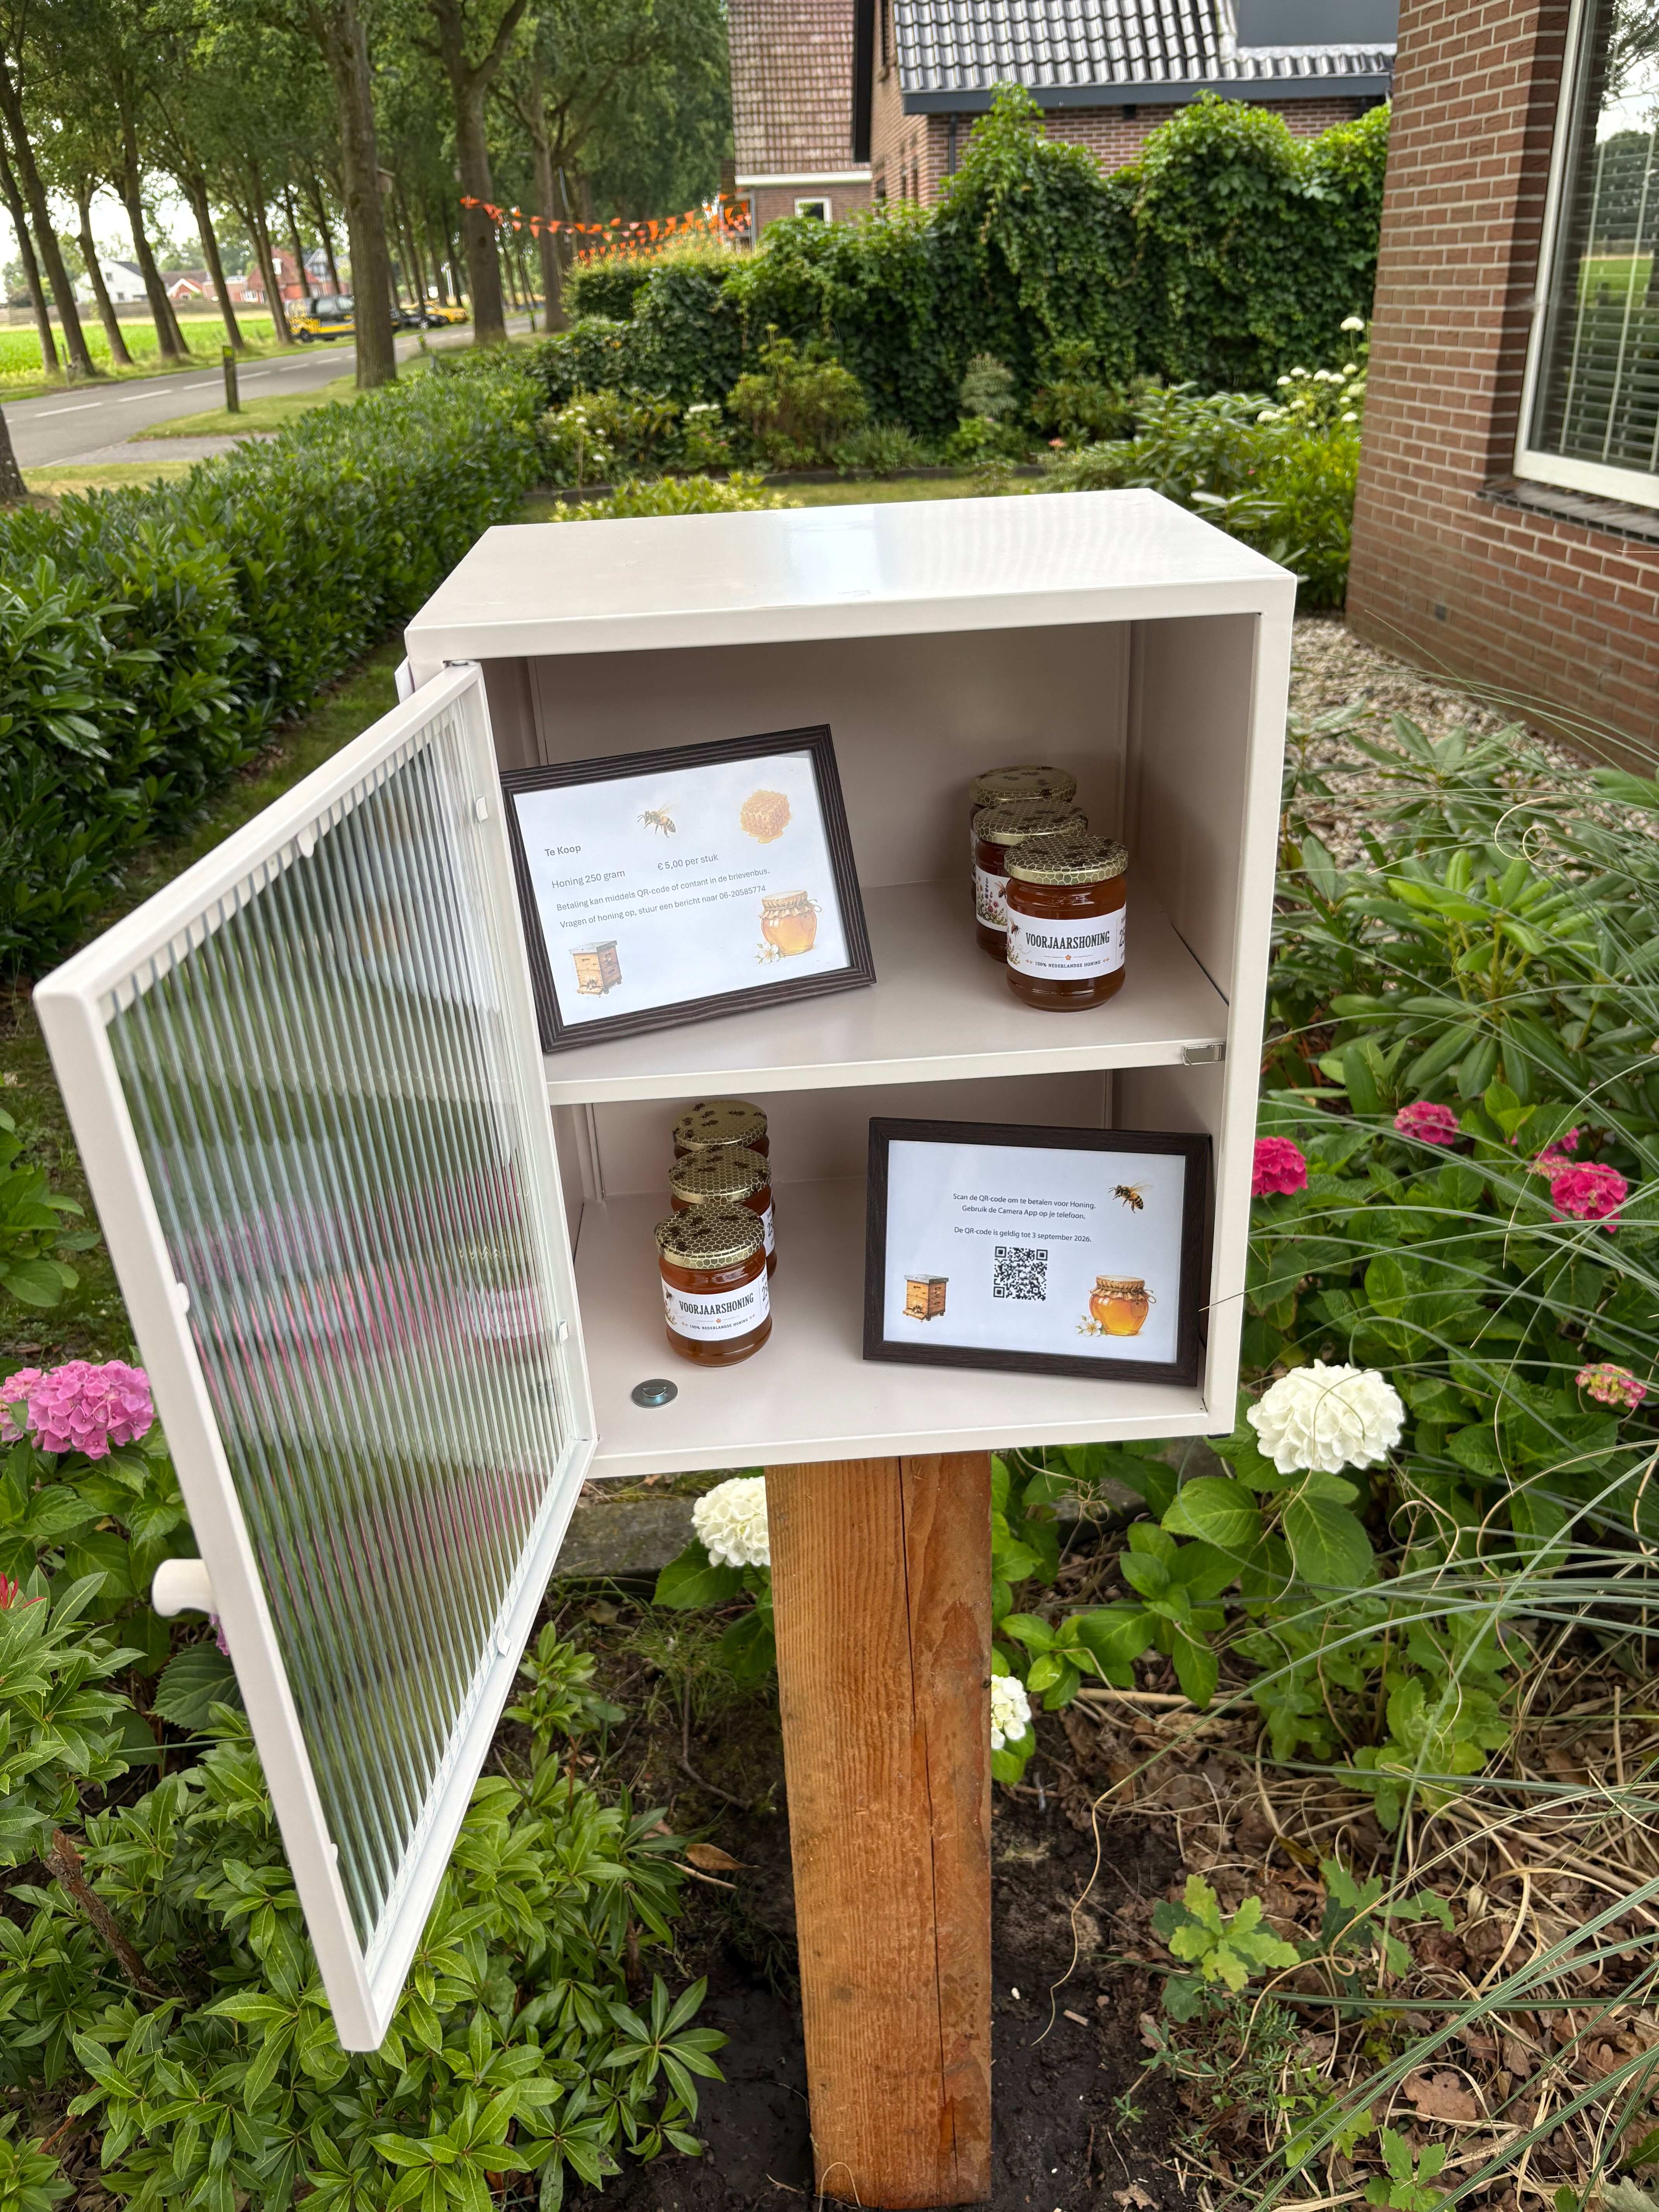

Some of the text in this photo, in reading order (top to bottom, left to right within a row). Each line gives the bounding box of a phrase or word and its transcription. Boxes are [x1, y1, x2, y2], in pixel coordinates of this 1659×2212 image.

[557, 846, 581, 855] Koop
[552, 877, 584, 888] Honing
[585, 873, 601, 883] 250
[604, 871, 625, 881] gram
[665, 859, 683, 869] 5,00
[685, 858, 698, 867] per
[701, 854, 719, 863] stuk
[557, 900, 588, 910] Betaling
[605, 891, 635, 902] middels
[637, 886, 670, 897] QR-code
[681, 878, 708, 889] contant
[728, 868, 769, 880] brievenbus.
[560, 919, 587, 927] Vragen
[598, 912, 624, 921] honing
[639, 905, 657, 914] stuur
[675, 897, 700, 907] bericht
[702, 895, 718, 903] naar
[719, 885, 766, 899] 06-20585774
[1026, 931, 1109, 949] VOORJAARSHONING
[1070, 1201, 1096, 1210] Honing.
[679, 1293, 754, 1315] VOORJAARSHONING
[733, 1318, 748, 1326] HONING
